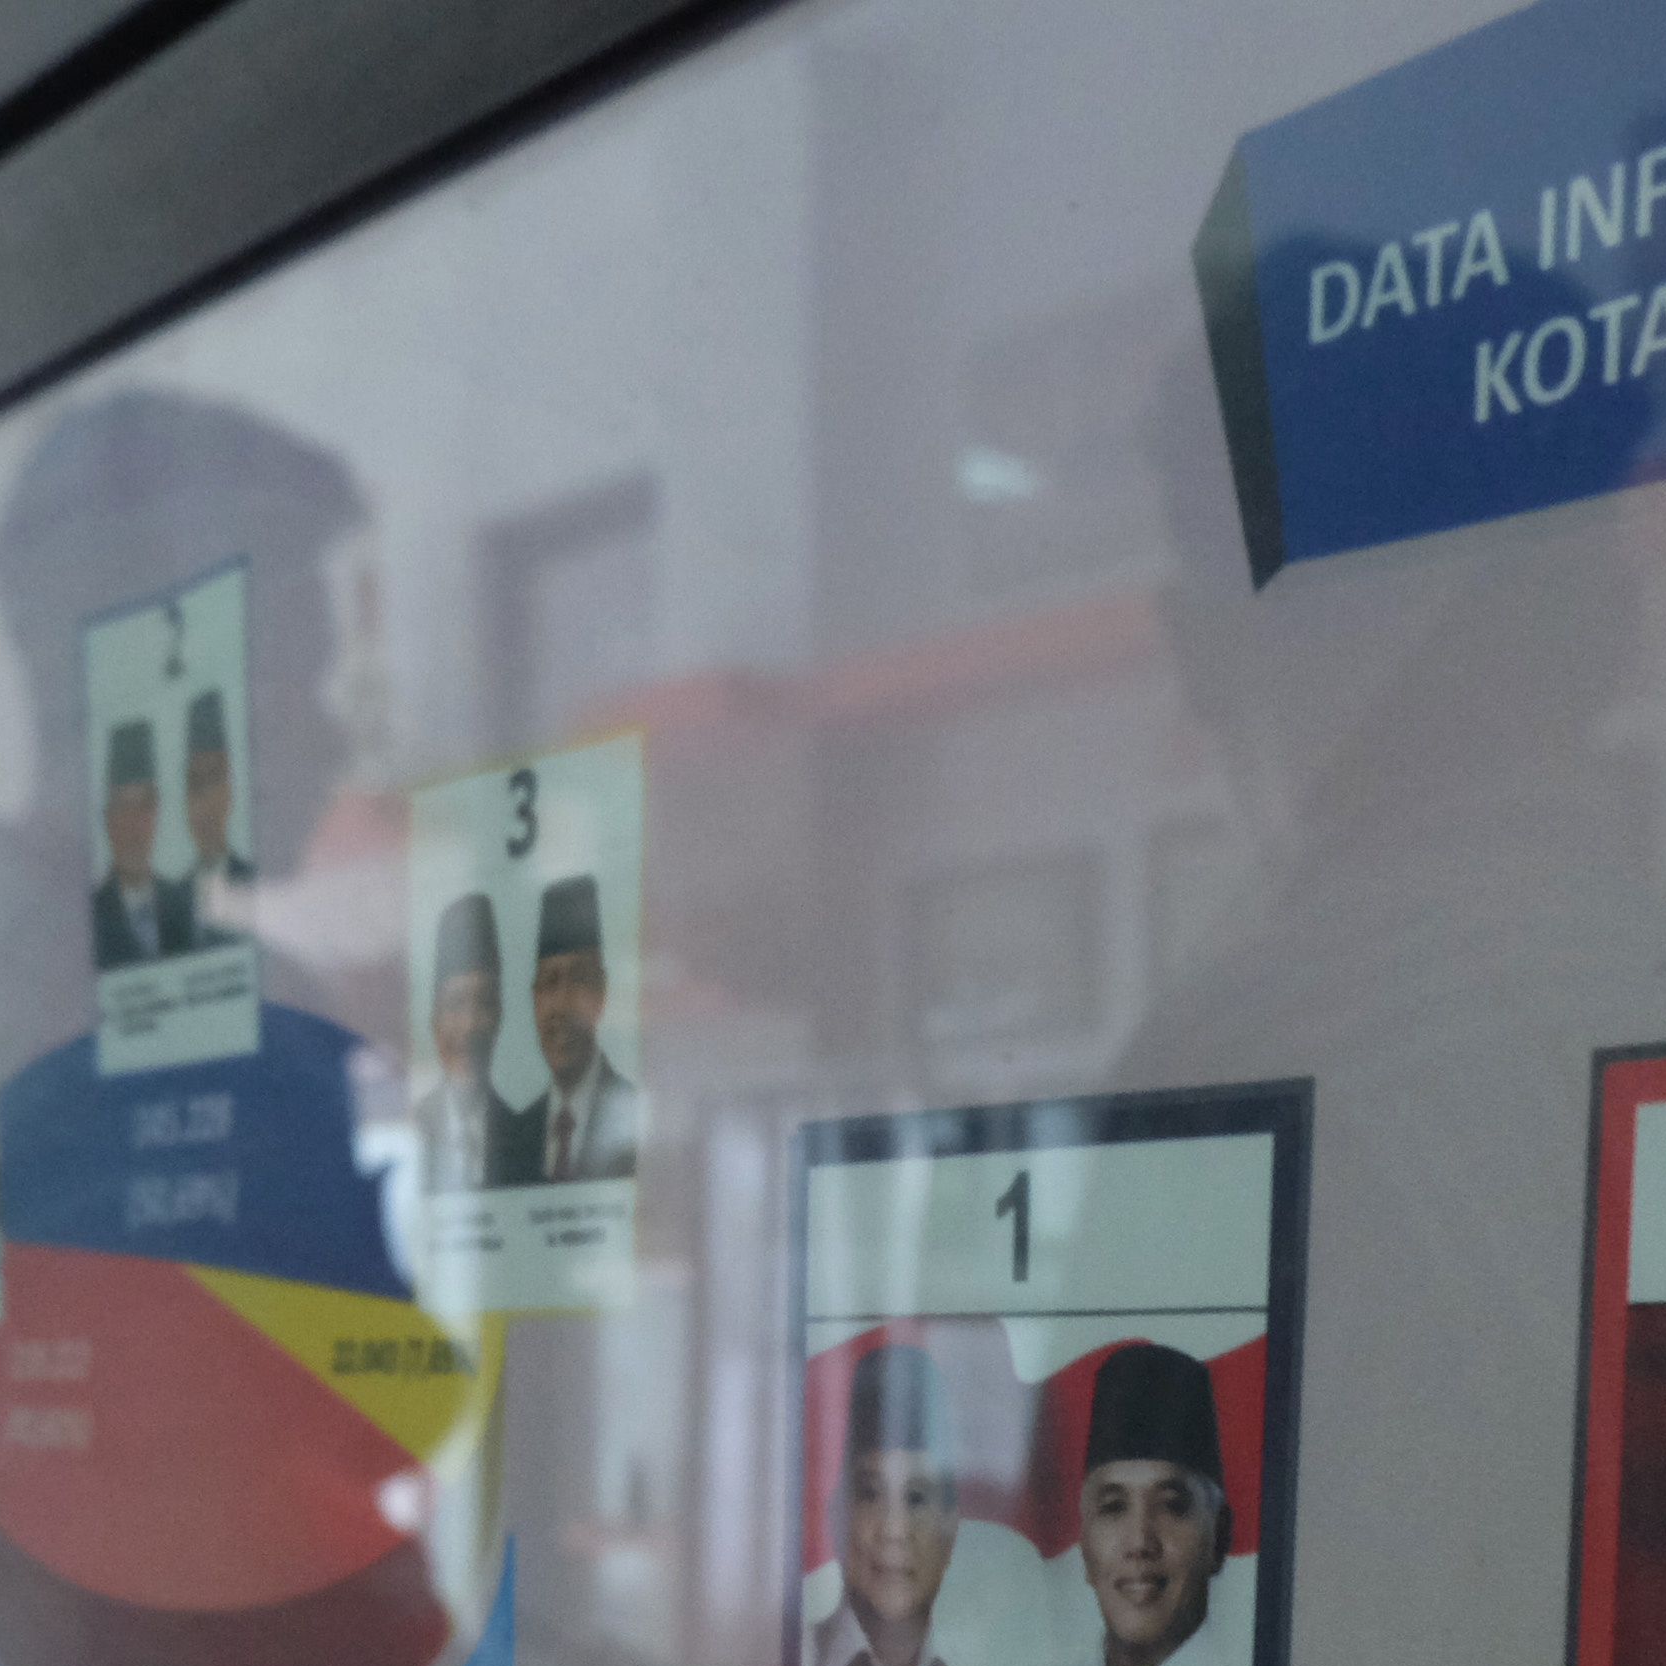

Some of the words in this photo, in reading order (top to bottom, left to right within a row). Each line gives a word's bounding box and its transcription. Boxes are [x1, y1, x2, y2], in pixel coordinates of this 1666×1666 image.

[1308, 208, 1510, 346] DATA
[507, 768, 539, 859] 3
[995, 1169, 1031, 1283] 1
